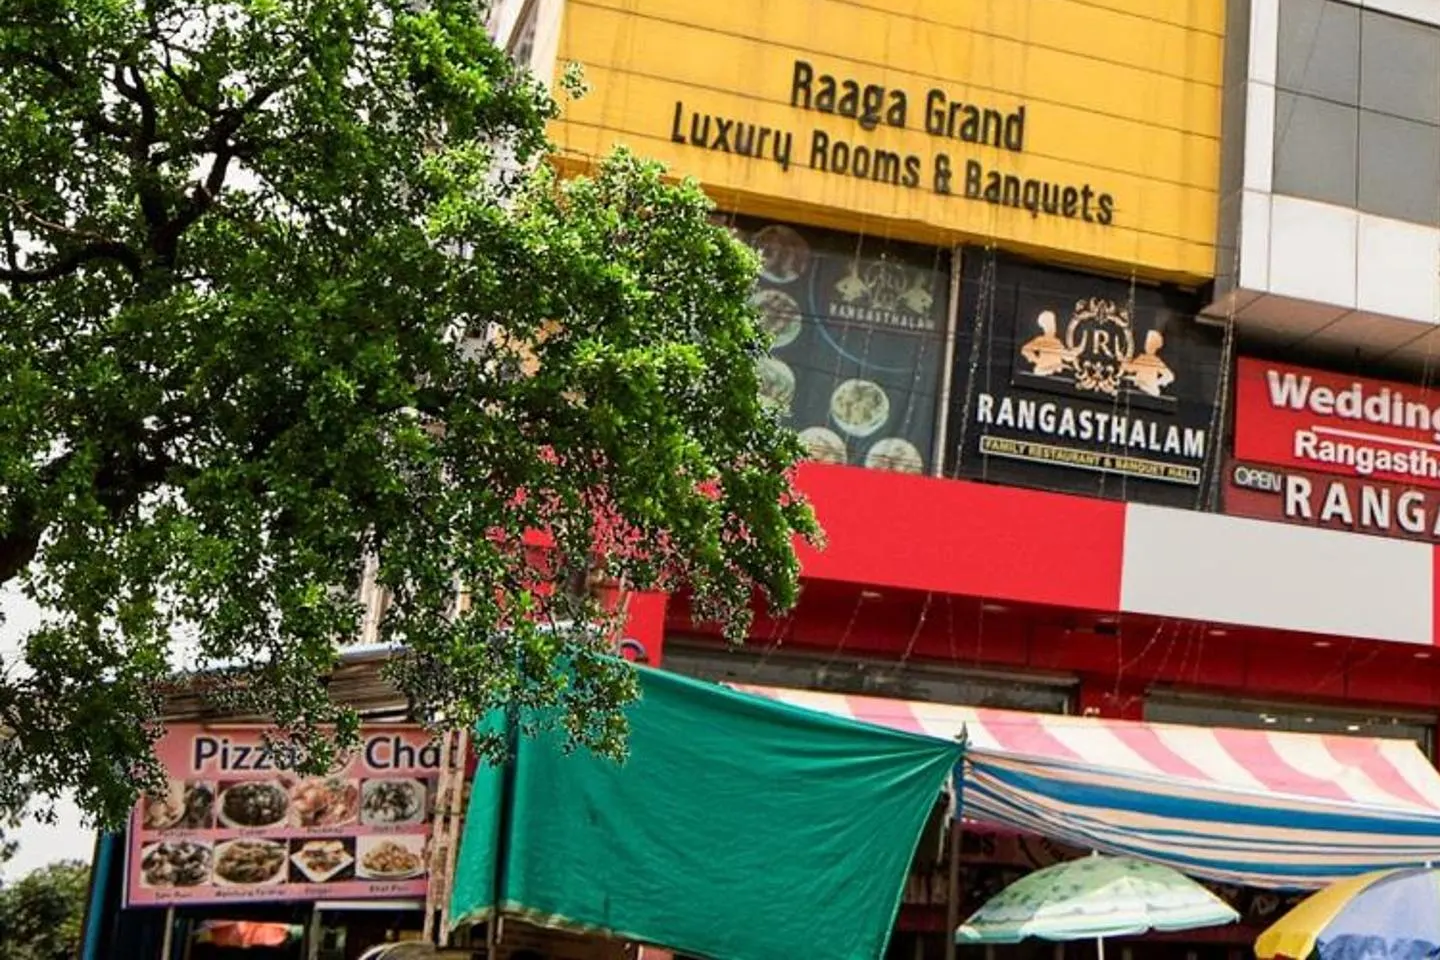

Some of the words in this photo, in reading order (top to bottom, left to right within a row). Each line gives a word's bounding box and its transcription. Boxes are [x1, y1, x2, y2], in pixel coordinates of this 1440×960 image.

[790, 60, 908, 131] Raaga
[924, 88, 1026, 152] Grand
[671, 101, 792, 172] Luxury
[809, 129, 921, 189] Rooms
[933, 152, 952, 196] &
[963, 158, 1115, 226] Banquets
[976, 393, 1205, 459] RANGASTHALAM
[985, 438, 1026, 455] FAMILY
[1028, 444, 1100, 466] RESTAURANT
[1114, 458, 1165, 477] BANQUET
[1167, 466, 1197, 482] HALL
[1234, 466, 1282, 492] OPEN
[193, 736, 298, 771] Pizza
